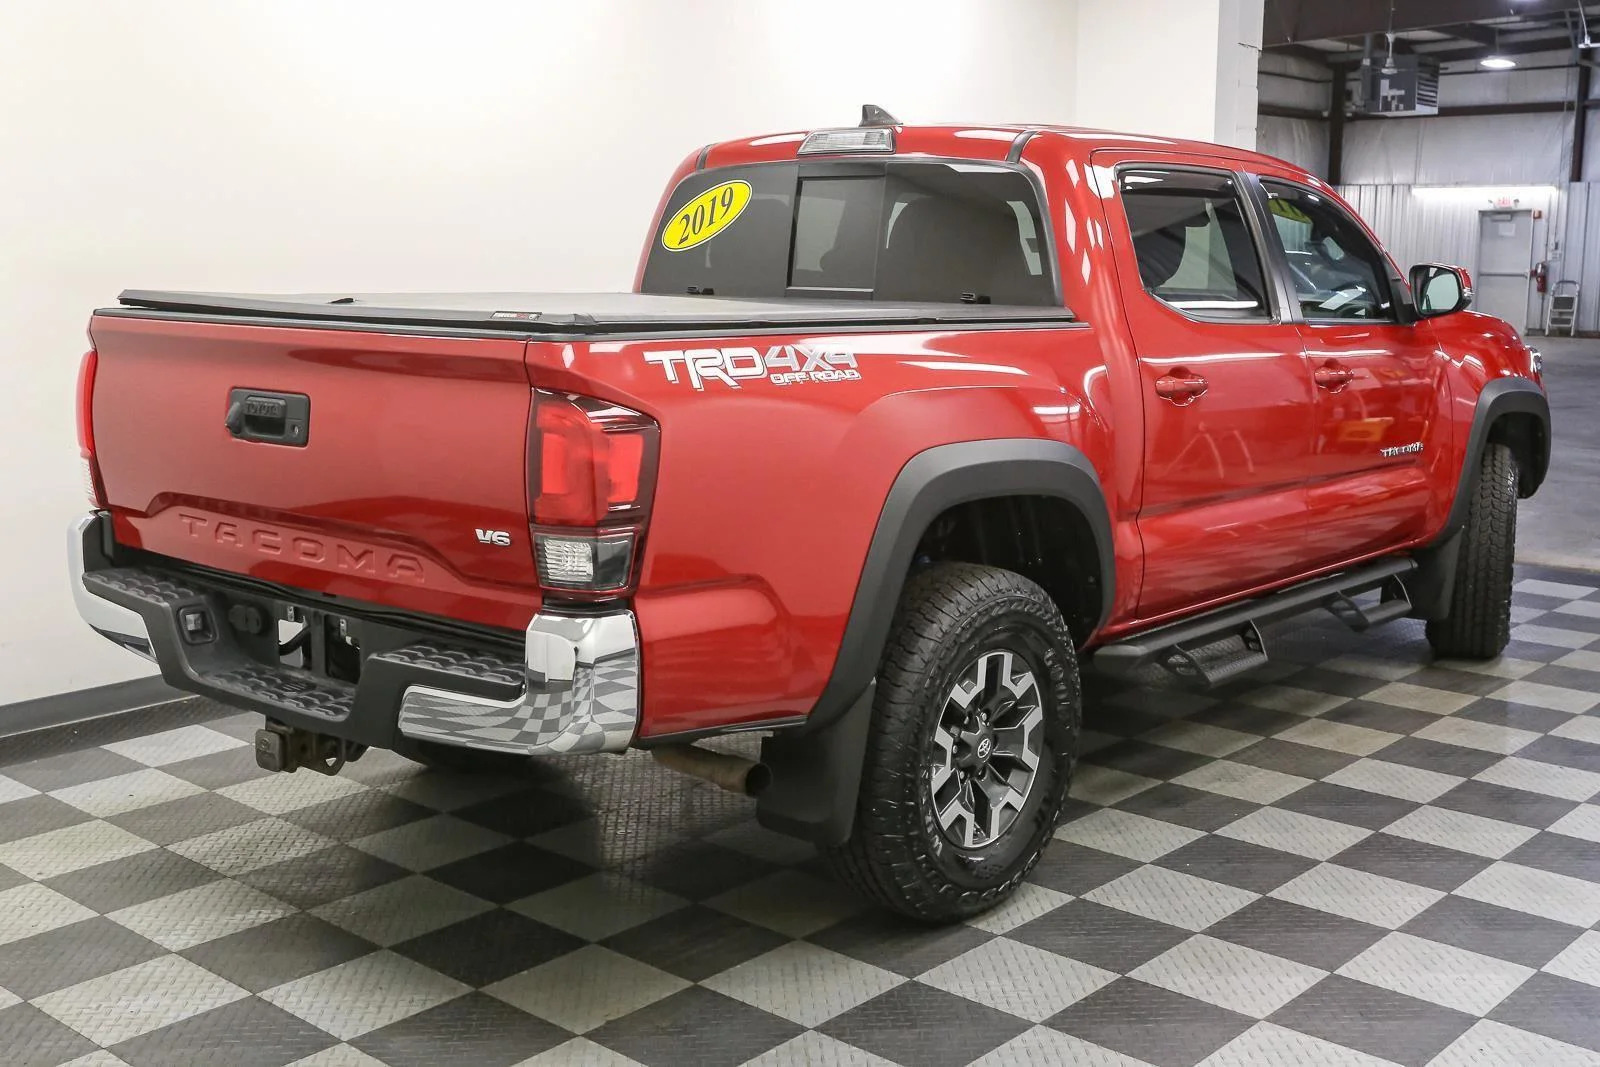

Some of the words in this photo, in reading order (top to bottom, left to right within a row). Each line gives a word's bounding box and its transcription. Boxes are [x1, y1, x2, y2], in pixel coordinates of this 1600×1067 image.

[678, 187, 734, 246] 2019
[643, 346, 767, 391] TRD
[178, 513, 425, 583] TACOMA
[474, 528, 511, 546] V6
